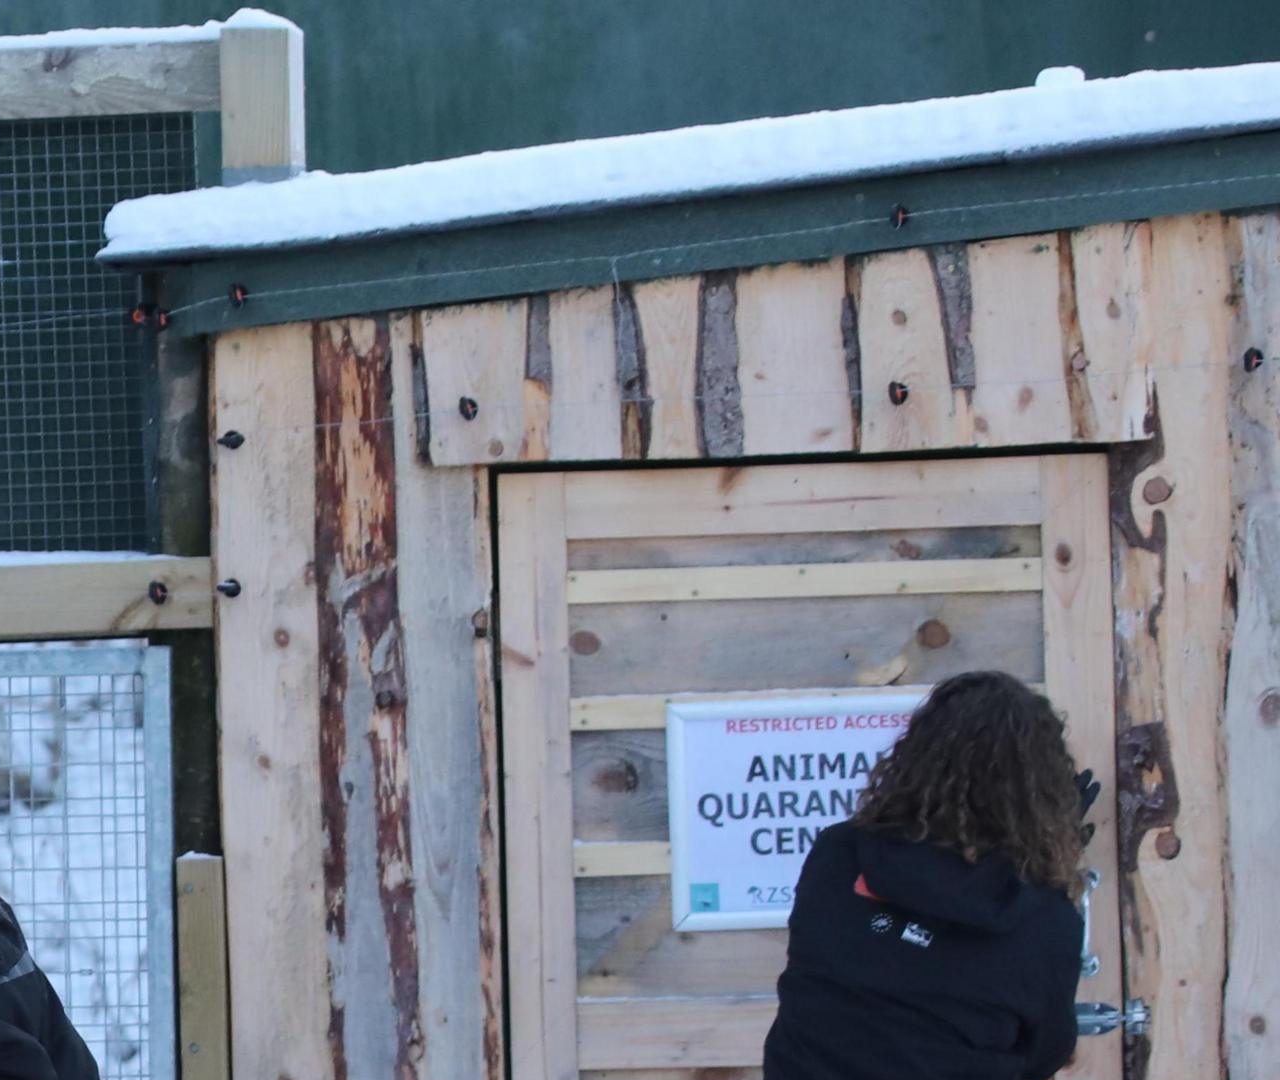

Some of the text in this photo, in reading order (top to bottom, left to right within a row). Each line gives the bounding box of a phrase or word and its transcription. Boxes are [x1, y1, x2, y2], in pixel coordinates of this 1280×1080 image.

[725, 714, 913, 733] RESTRICTED ACCESS
[746, 752, 884, 782] ANIMA
[697, 789, 864, 828] QUARAN
